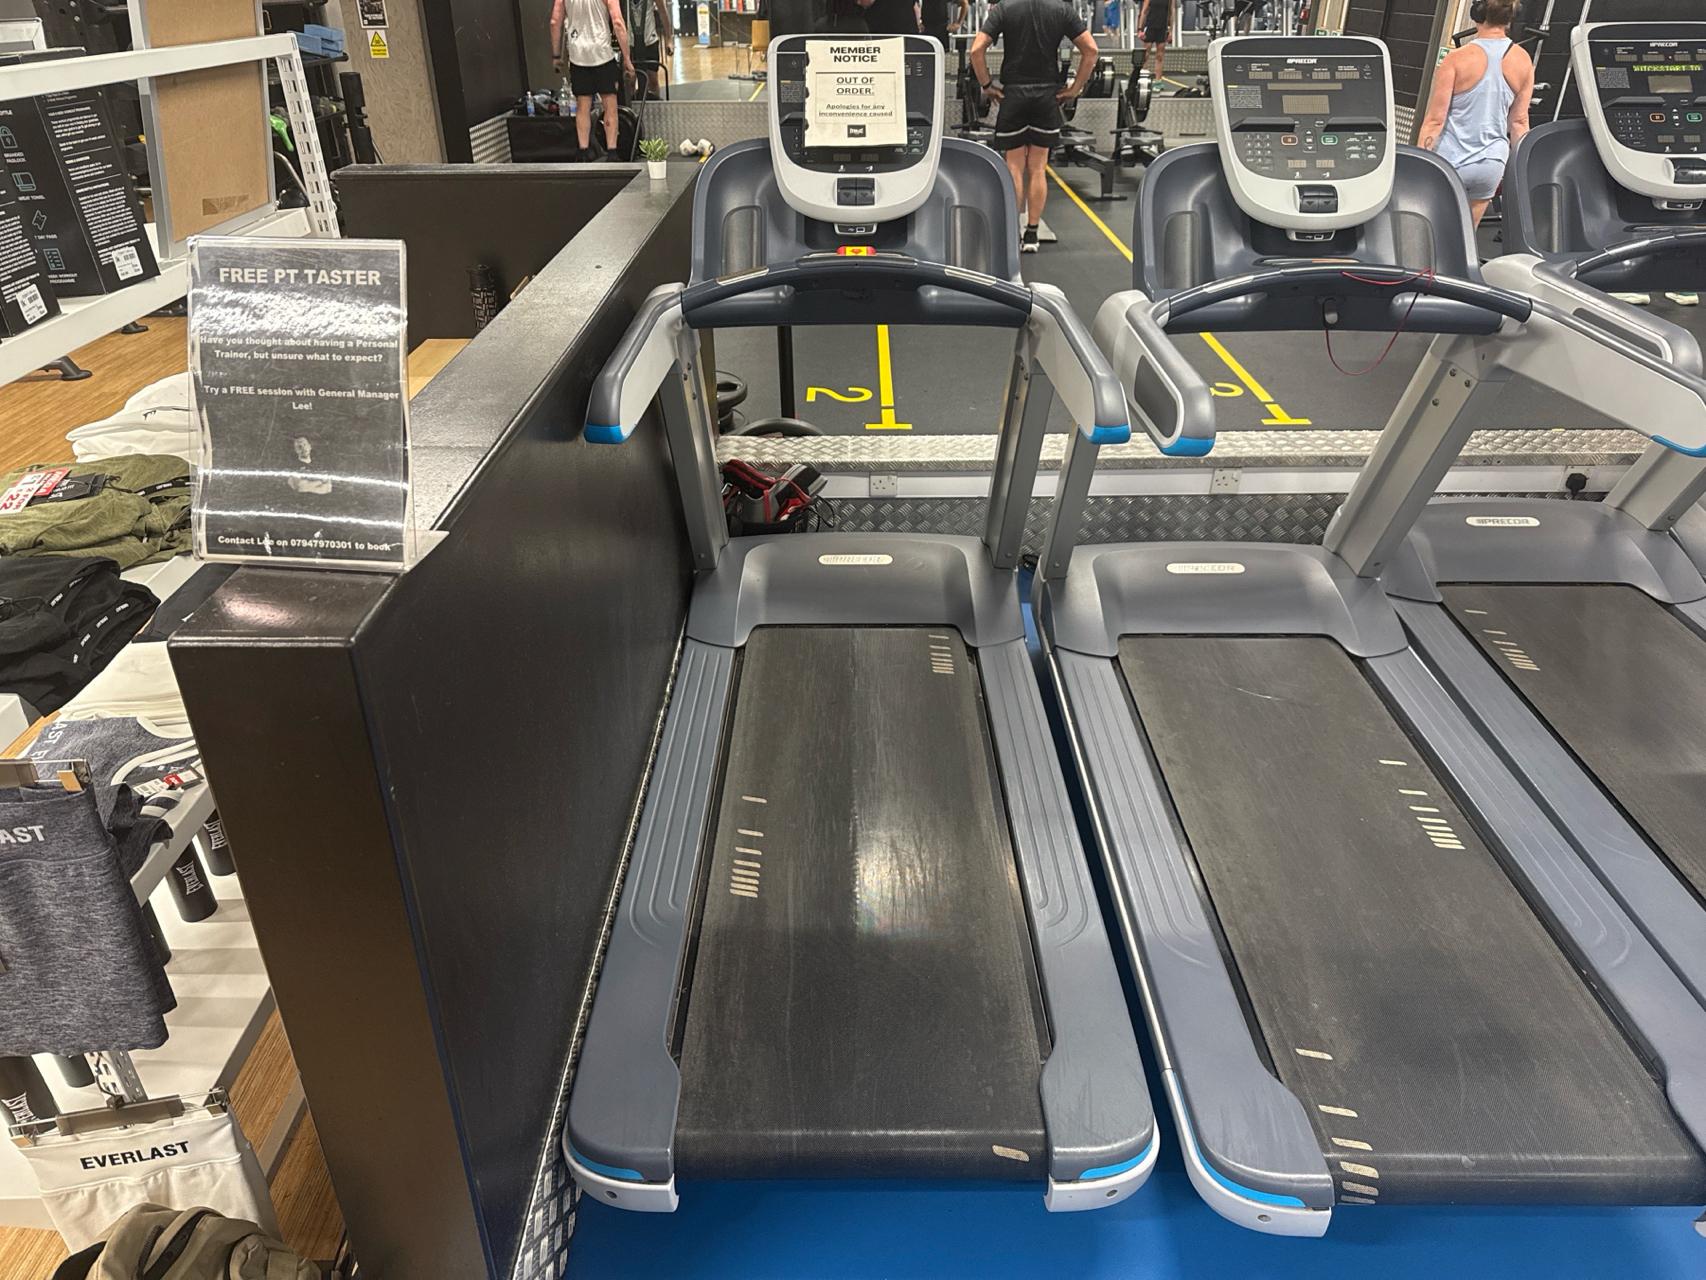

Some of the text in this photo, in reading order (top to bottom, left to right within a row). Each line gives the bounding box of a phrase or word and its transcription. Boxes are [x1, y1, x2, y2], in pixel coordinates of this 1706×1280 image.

[829, 46, 881, 54] MEMBER
[833, 55, 878, 63] NOTICE
[836, 76, 875, 84] OUT OF
[836, 87, 875, 95] ORDER.
[219, 267, 381, 286] FREE PT TASTER
[200, 335, 224, 344] Have
[245, 336, 282, 347] thought
[284, 338, 311, 346] about
[313, 338, 345, 349] having
[356, 340, 398, 348] Personal
[214, 350, 252, 360] Trainer,
[253, 351, 269, 359] but
[306, 352, 330, 361] what
[331, 353, 343, 361] to
[344, 354, 383, 364] expect?
[203, 385, 220, 396] Try
[229, 386, 256, 395] FREE
[257, 387, 294, 396] session
[295, 388, 316, 397] with
[318, 388, 356, 398] General
[357, 389, 400, 401] Manager
[805, 387, 873, 403] 2
[292, 402, 313, 411] Lee!
[217, 535, 392, 551] Contact Le on 07947970301 to book
[1, 1090, 35, 1123] ERLAST
[80, 1140, 189, 1170] EVERLAST
